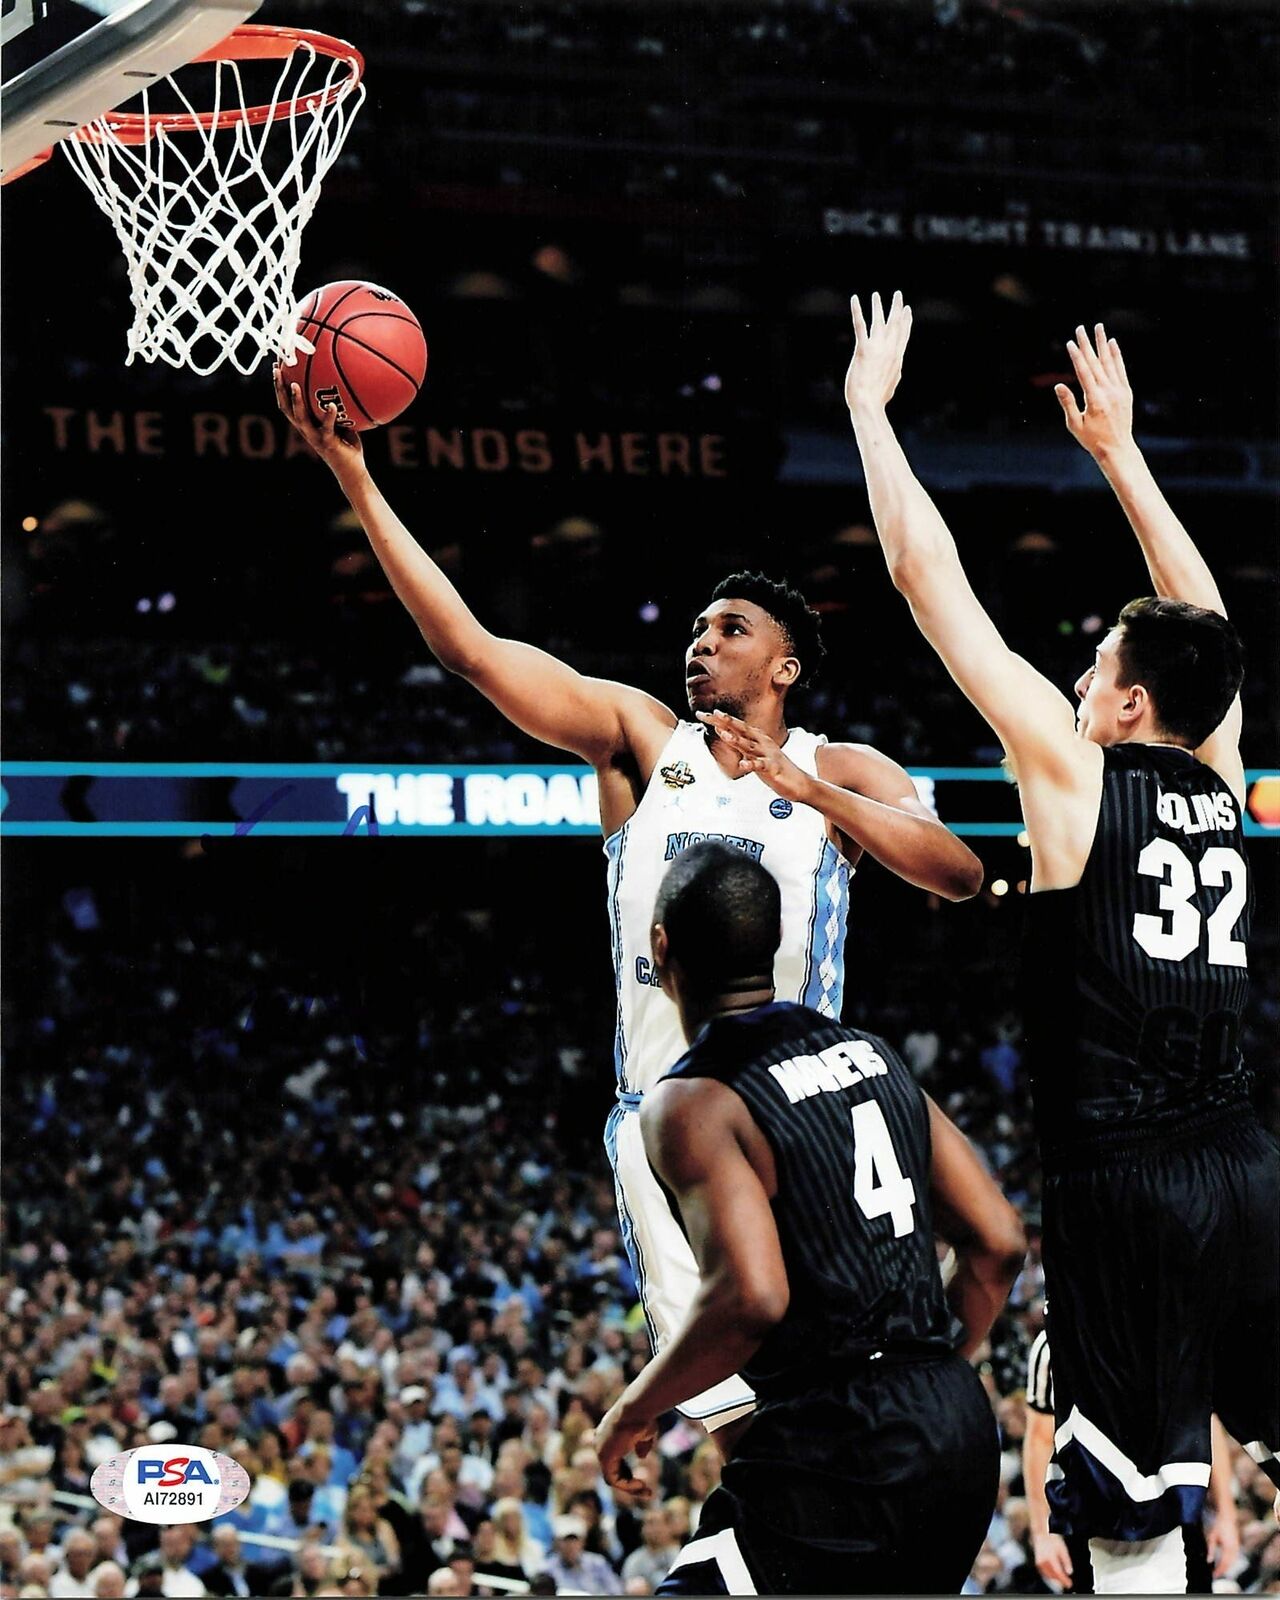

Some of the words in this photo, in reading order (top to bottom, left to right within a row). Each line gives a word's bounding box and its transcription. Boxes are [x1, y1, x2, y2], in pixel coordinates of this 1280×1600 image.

[823, 207, 898, 237] DICK
[1165, 230, 1249, 258] LANE
[44, 406, 165, 455] THE
[387, 425, 552, 473] ENDS
[574, 431, 727, 478] HERE
[337, 773, 454, 826] THE
[1132, 836, 1247, 968] 32
[850, 1099, 916, 1238] 4
